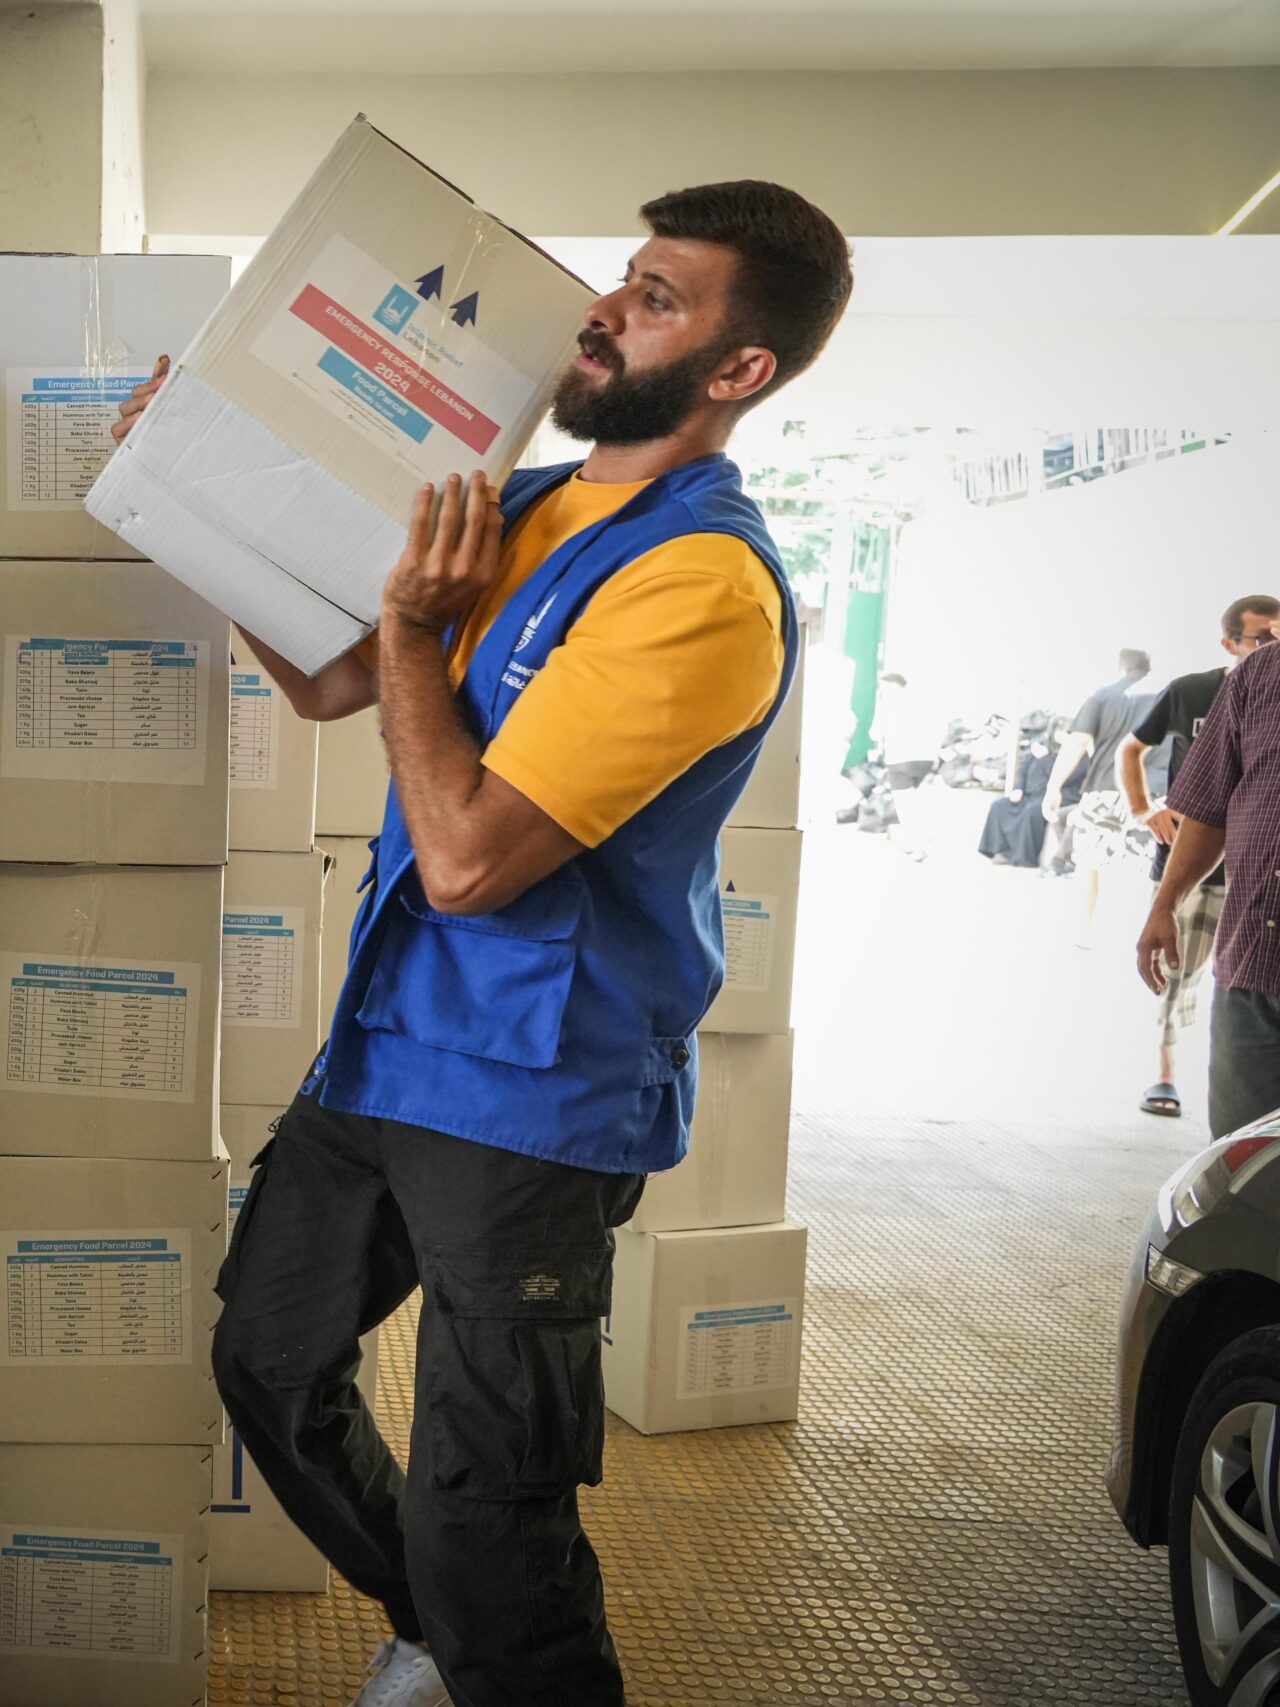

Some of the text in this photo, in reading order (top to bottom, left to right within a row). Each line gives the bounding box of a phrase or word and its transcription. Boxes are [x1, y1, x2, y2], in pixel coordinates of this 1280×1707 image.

[326, 307, 382, 350] EMERGENCY
[382, 349, 430, 387] RESPONSE
[431, 385, 473, 419] LEBANON
[374, 362, 410, 392] 2024
[48, 380, 94, 389] Emergency
[224, 916, 269, 924] Parcel 2024
[38, 967, 158, 981] Emergency Food Parcel 2024
[32, 1242, 77, 1251] Emergency
[130, 1241, 152, 1249] 2024
[27, 1537, 72, 1548] Emergency
[74, 1540, 93, 1548] Food
[123, 1543, 144, 1551] 2024
